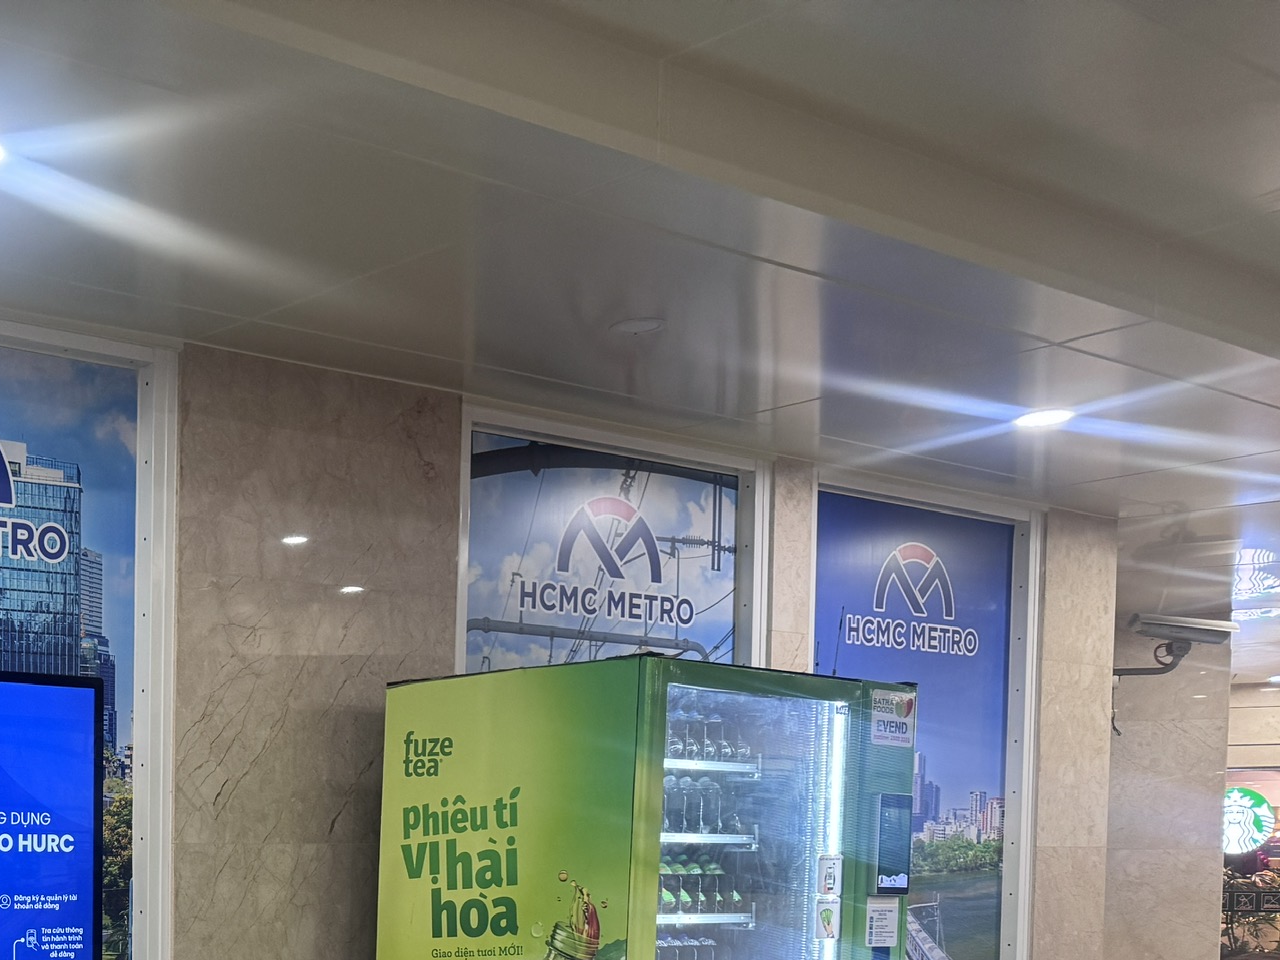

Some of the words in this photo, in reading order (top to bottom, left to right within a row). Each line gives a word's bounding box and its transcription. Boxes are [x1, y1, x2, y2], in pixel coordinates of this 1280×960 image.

[519, 580, 598, 615] HCMC
[607, 589, 694, 625] METRO
[847, 615, 906, 648] HCMC
[911, 622, 978, 655] METRO
[877, 720, 908, 734] EVEND
[404, 731, 453, 757] fuze
[403, 756, 439, 778] tea
[11, 812, 51, 828] DỤNG
[18, 834, 74, 852] HURC
[446, 836, 518, 891] hài
[431, 892, 519, 939] hòa
[431, 947, 452, 959] Giao
[454, 946, 475, 960] diện
[498, 945, 523, 957] MỚI!
